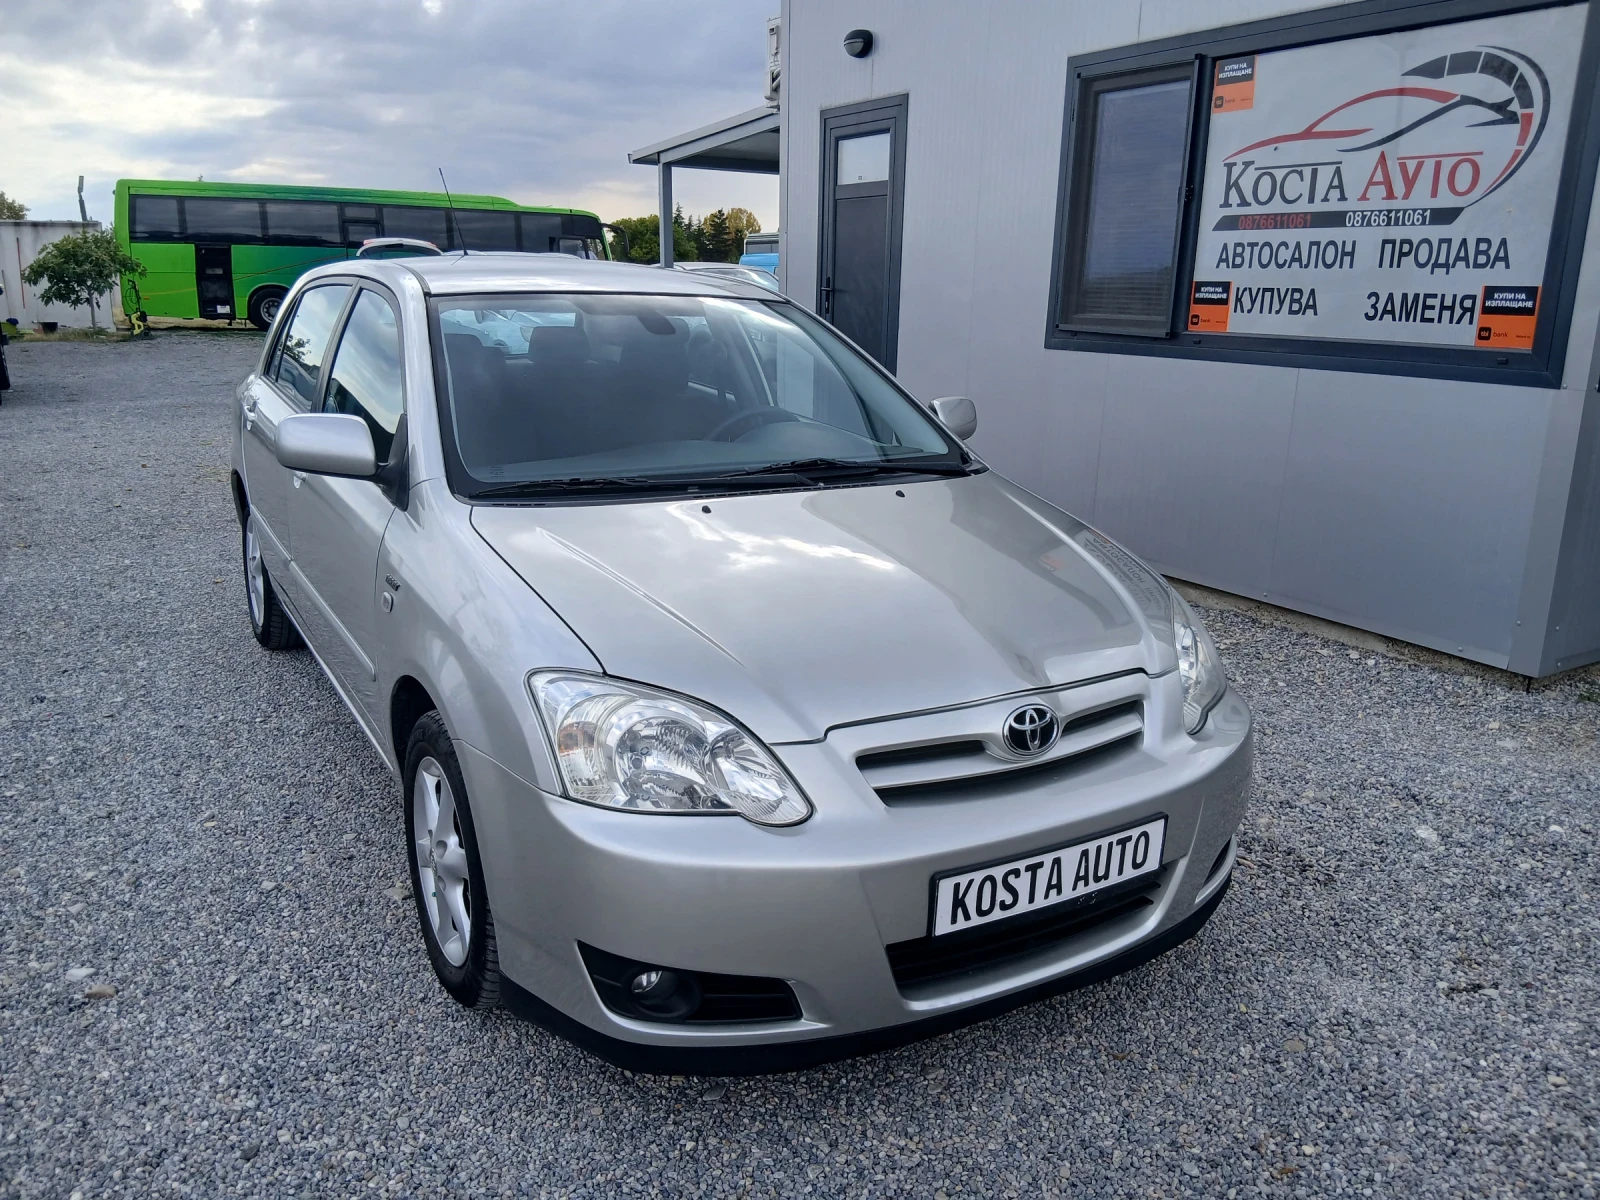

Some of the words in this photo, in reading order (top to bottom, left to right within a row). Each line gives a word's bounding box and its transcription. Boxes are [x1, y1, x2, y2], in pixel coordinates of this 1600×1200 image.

[1218, 68, 1252, 78] ИЗПЛАЩАНЕ
[1238, 213, 1311, 230] 0876611061
[1345, 209, 1431, 227] 0876611061
[1216, 240, 1356, 269] АВТОСАЛОН
[1378, 237, 1510, 275] ПРОДАВА
[1233, 287, 1318, 316] КУПУВА
[1364, 291, 1477, 325] ЗАМЕНЯ
[1485, 300, 1533, 308] ИЗПЛАЩАНЕ
[1493, 292, 1514, 300] КУПИ
[1515, 292, 1526, 300] НА
[950, 856, 1062, 925] KOSTA
[1072, 830, 1150, 891] AUTO
